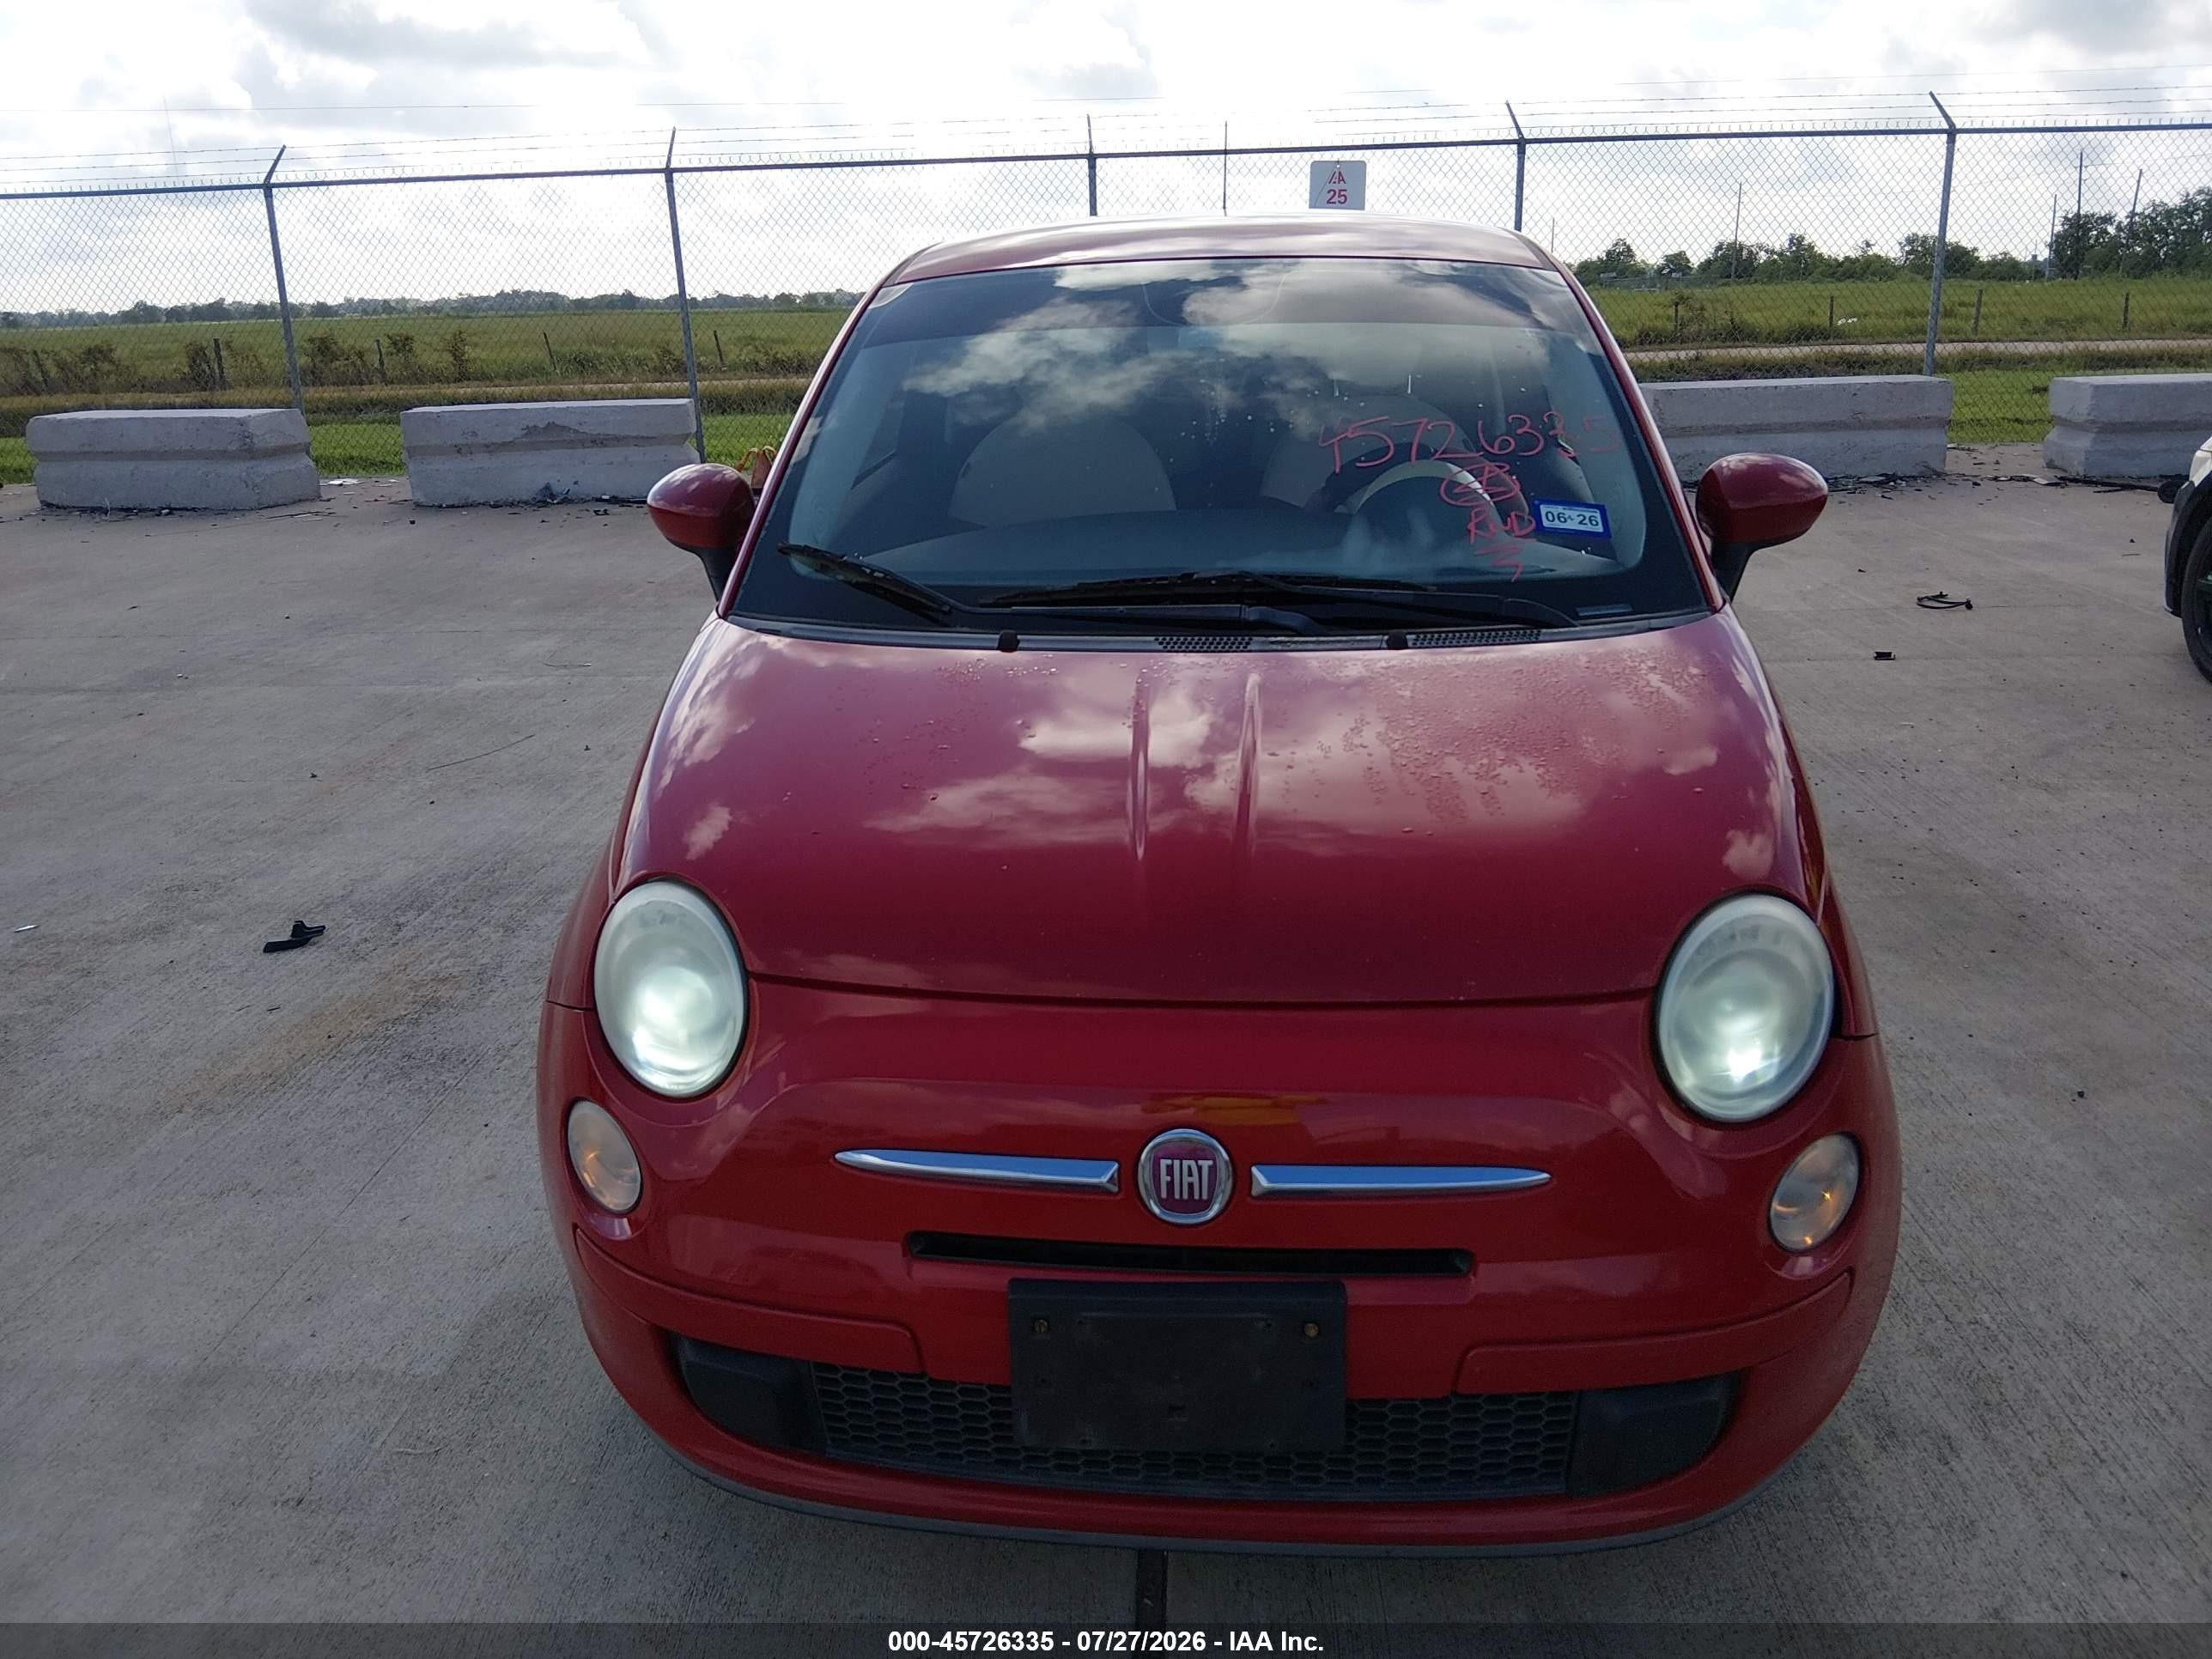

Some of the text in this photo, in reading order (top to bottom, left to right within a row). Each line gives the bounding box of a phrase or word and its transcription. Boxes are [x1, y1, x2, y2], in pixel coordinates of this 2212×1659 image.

[1327, 189, 1347, 204] 25
[1545, 510, 1600, 527] 06 26
[1159, 1158, 1214, 1200] FIAT
